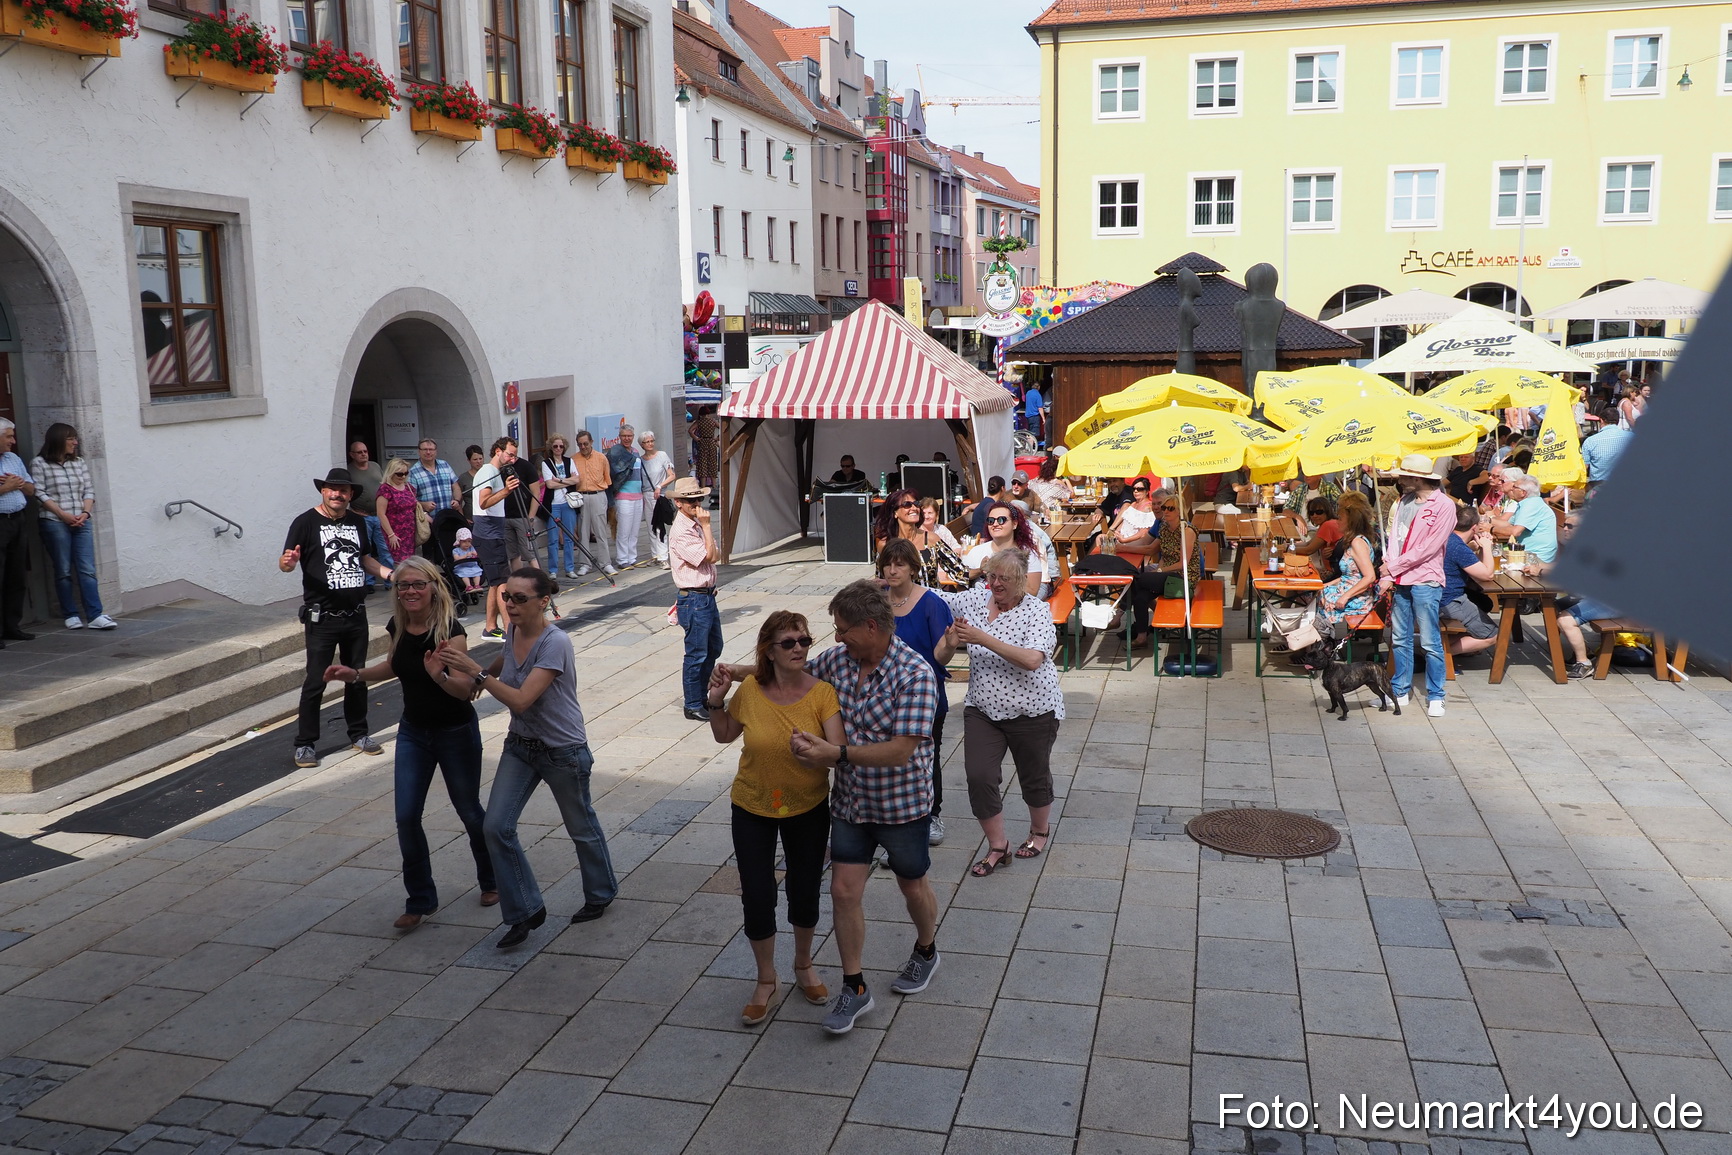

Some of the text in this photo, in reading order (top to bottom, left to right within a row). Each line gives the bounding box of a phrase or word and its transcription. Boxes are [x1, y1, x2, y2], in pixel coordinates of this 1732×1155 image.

[1431, 248, 1474, 268] CAFÉ
[1477, 256, 1494, 267] AM
[1426, 334, 1518, 359] Glossner
[1473, 347, 1515, 357] Bier
[1662, 348, 1680, 357] widde
[1407, 417, 1444, 435] Glossner
[1429, 426, 1452, 434] Bräu
[1167, 430, 1215, 449] Glossner
[1324, 426, 1376, 448] Glossner
[1347, 437, 1373, 445] Bräu
